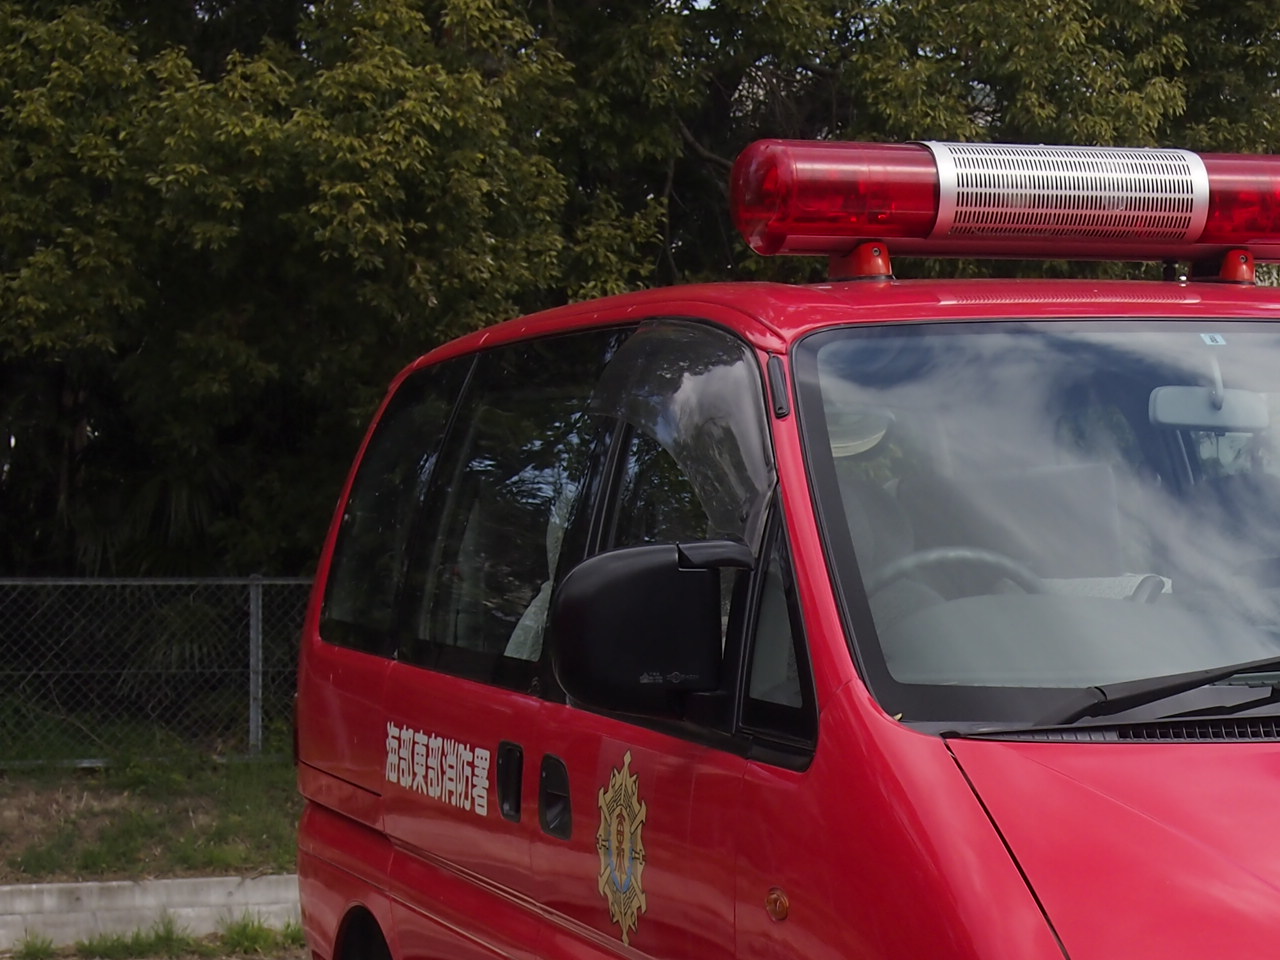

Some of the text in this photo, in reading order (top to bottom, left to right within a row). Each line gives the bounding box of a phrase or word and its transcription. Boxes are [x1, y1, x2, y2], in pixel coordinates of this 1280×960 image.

[385, 720, 490, 817] 海部東部消防署
